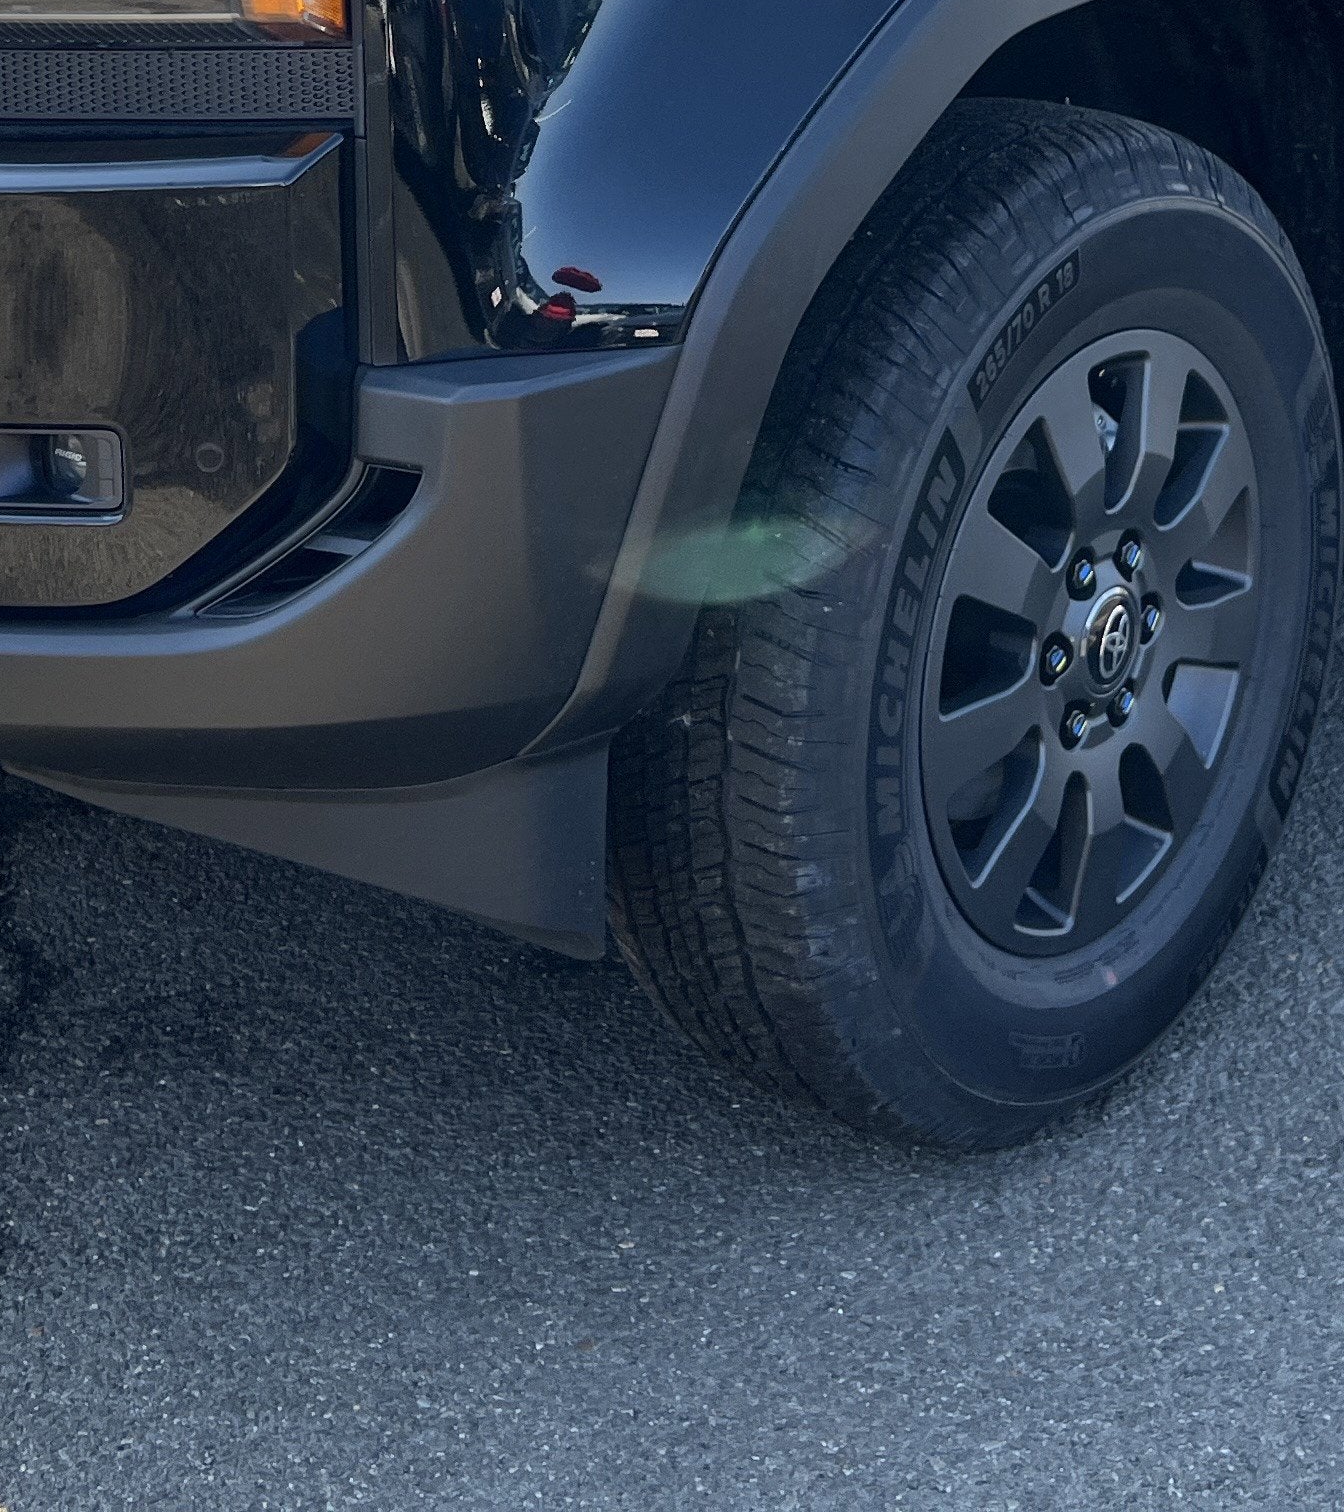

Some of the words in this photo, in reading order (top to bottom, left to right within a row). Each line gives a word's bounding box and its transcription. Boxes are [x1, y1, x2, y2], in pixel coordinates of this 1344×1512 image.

[976, 302, 1035, 400] 265/70
[1038, 283, 1052, 315] R
[1056, 261, 1074, 295] 18
[874, 454, 957, 837] MICHELIN
[1277, 488, 1338, 794] MICHELIN
